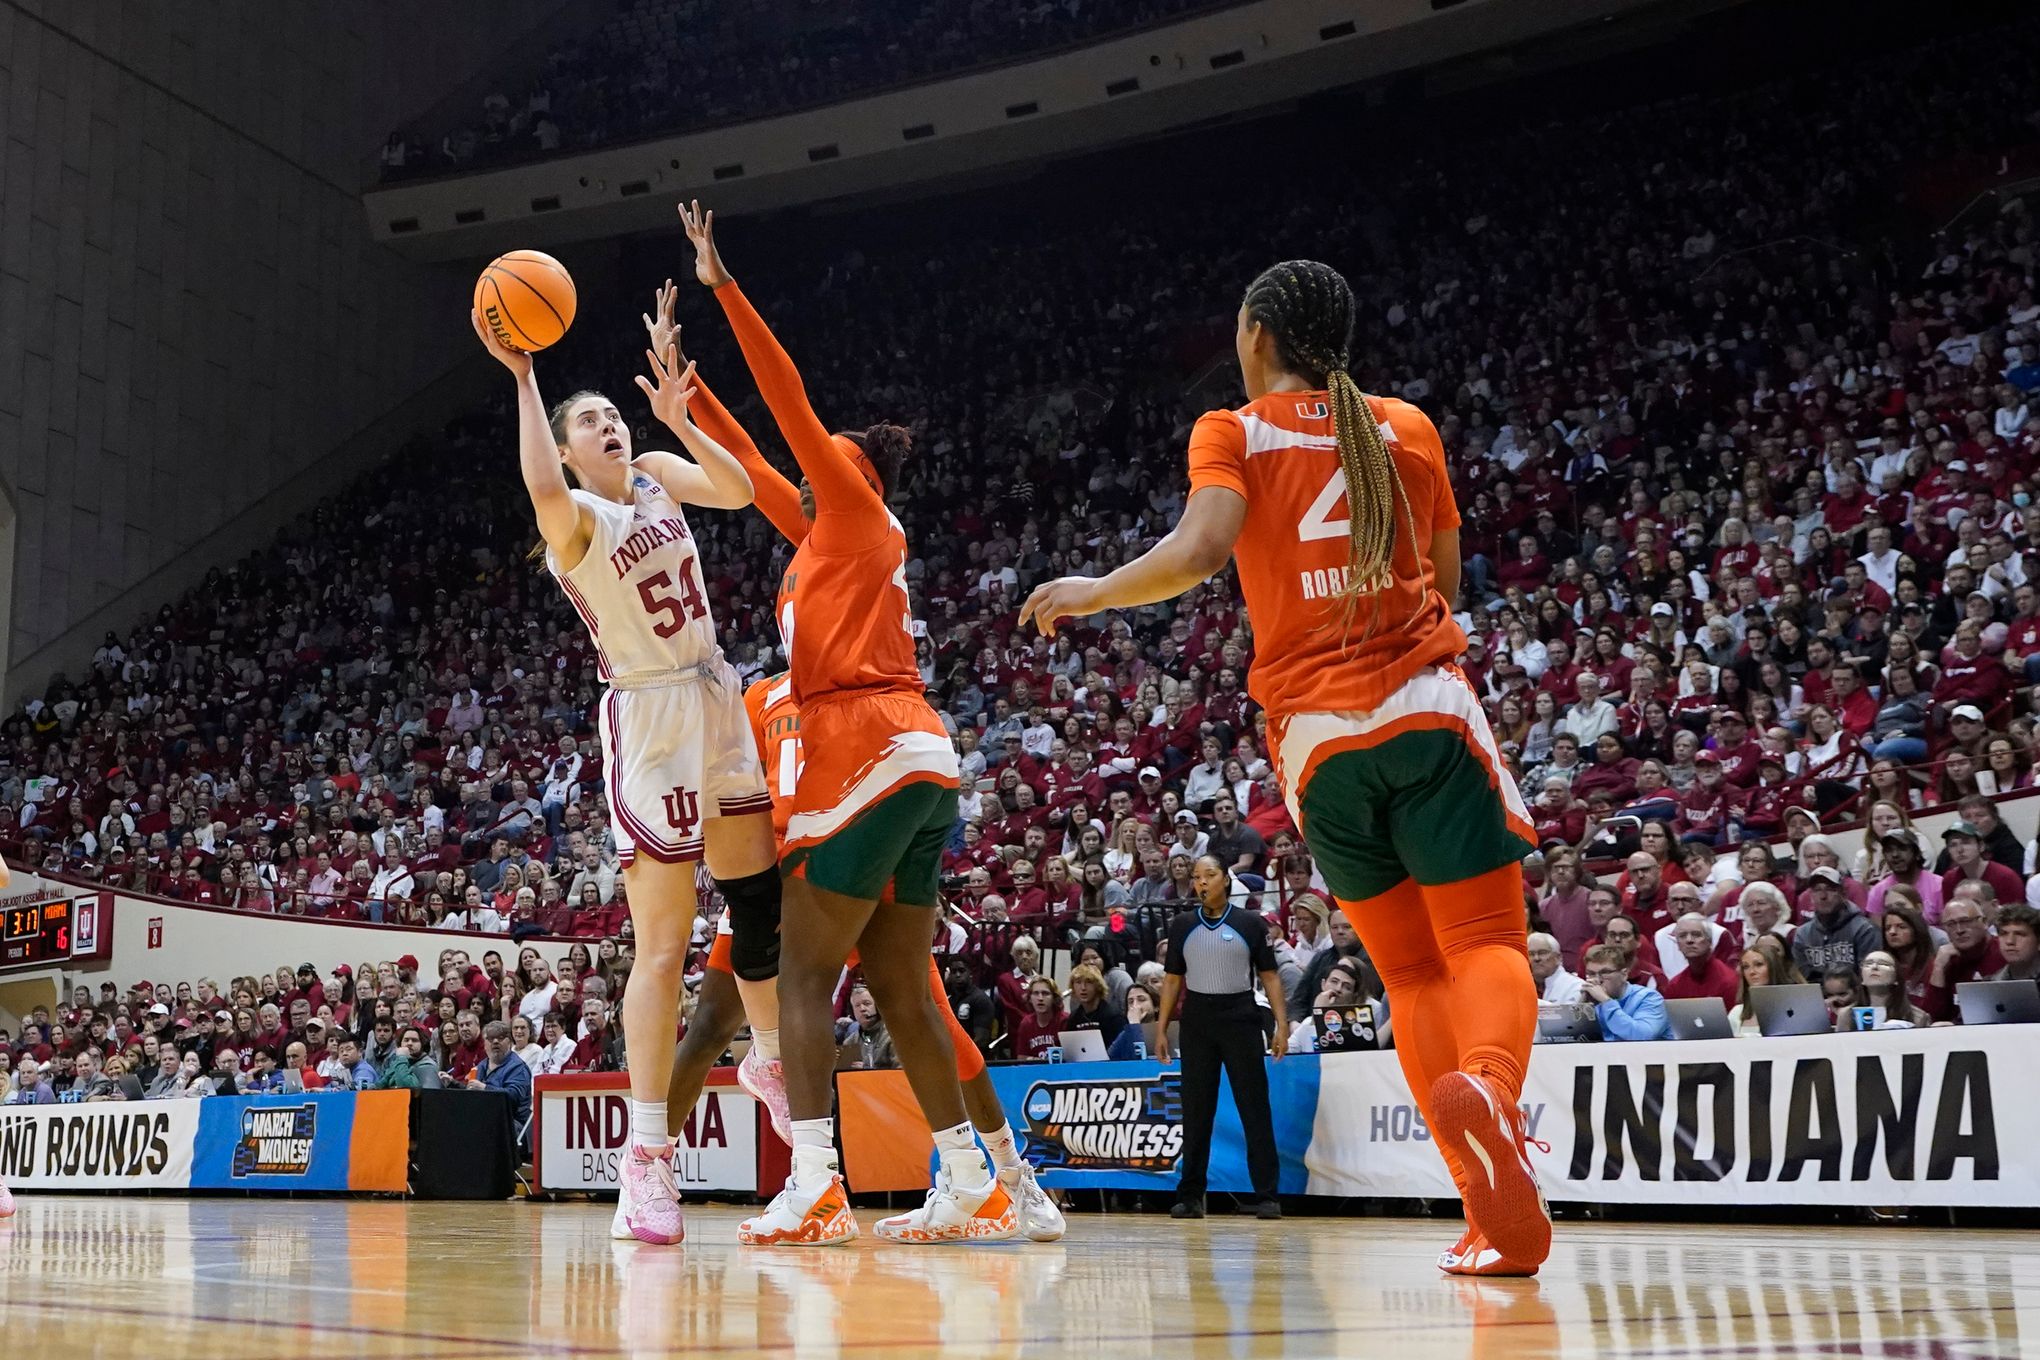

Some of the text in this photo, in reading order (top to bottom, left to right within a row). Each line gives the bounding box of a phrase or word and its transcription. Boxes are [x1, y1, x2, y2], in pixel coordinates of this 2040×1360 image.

[485, 304, 524, 351] Wilso
[1298, 466, 1353, 542] 4
[610, 518, 692, 580] INDIANA
[637, 555, 707, 638] 54
[13, 909, 38, 935] 3:17
[44, 903, 67, 920] MIAMI
[25, 943, 30, 956] 1
[57, 927, 67, 949] 16
[152, 928, 158, 946] 8
[566, 1092, 728, 1150] INDNA
[1050, 1087, 1142, 1123] MARCH
[1567, 1050, 1999, 1181] INDIANA
[252, 1112, 295, 1137] MARCH
[1062, 1124, 1184, 1158] MADNESS
[45, 1113, 169, 1176] ROUNDS
[582, 1153, 708, 1182] BASALL
